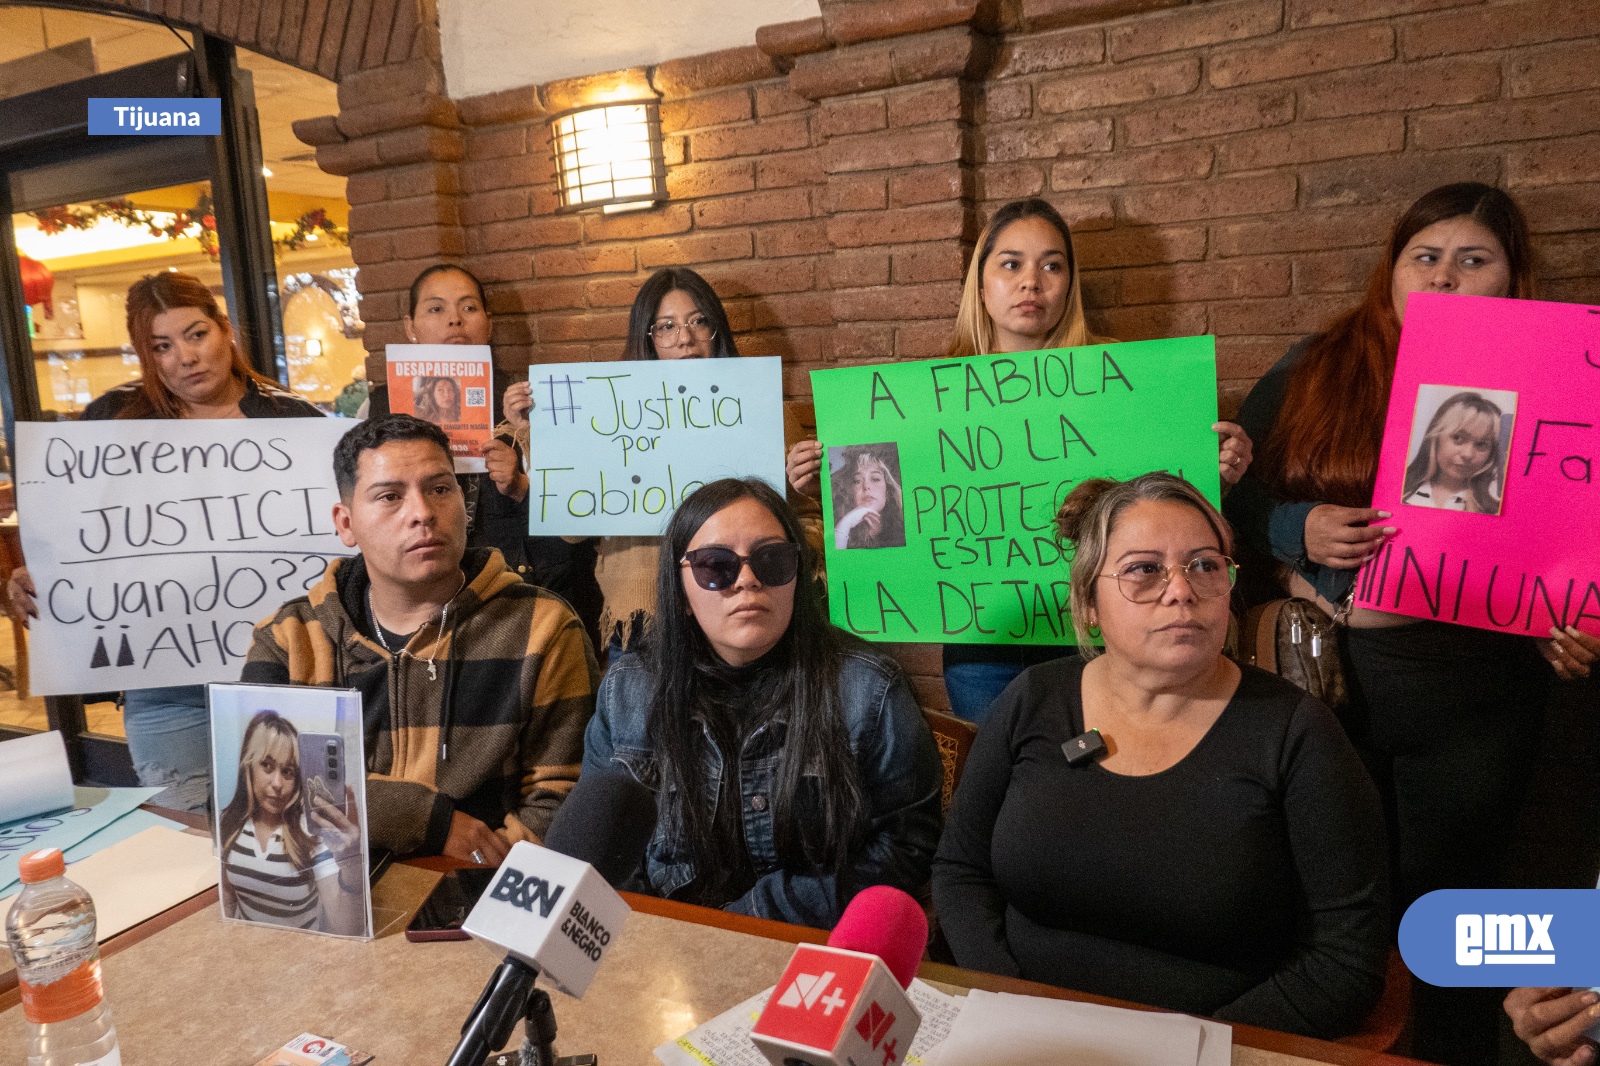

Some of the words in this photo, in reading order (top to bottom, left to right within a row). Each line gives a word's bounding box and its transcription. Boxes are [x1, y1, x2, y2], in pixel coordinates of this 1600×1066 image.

[395, 362, 484, 377] DESAPARECIDA
[870, 372, 906, 420] A
[930, 350, 1134, 413] FABIOLA
[538, 374, 743, 435] #Justicia
[611, 435, 660, 467] por
[938, 425, 1003, 473] NO
[1024, 414, 1097, 461] LA
[80, 487, 340, 554] JUSTICI
[843, 580, 920, 635] LA
[489, 867, 565, 919] B&N
[561, 917, 602, 962] &NEGRO
[570, 900, 611, 947] BLANCO
